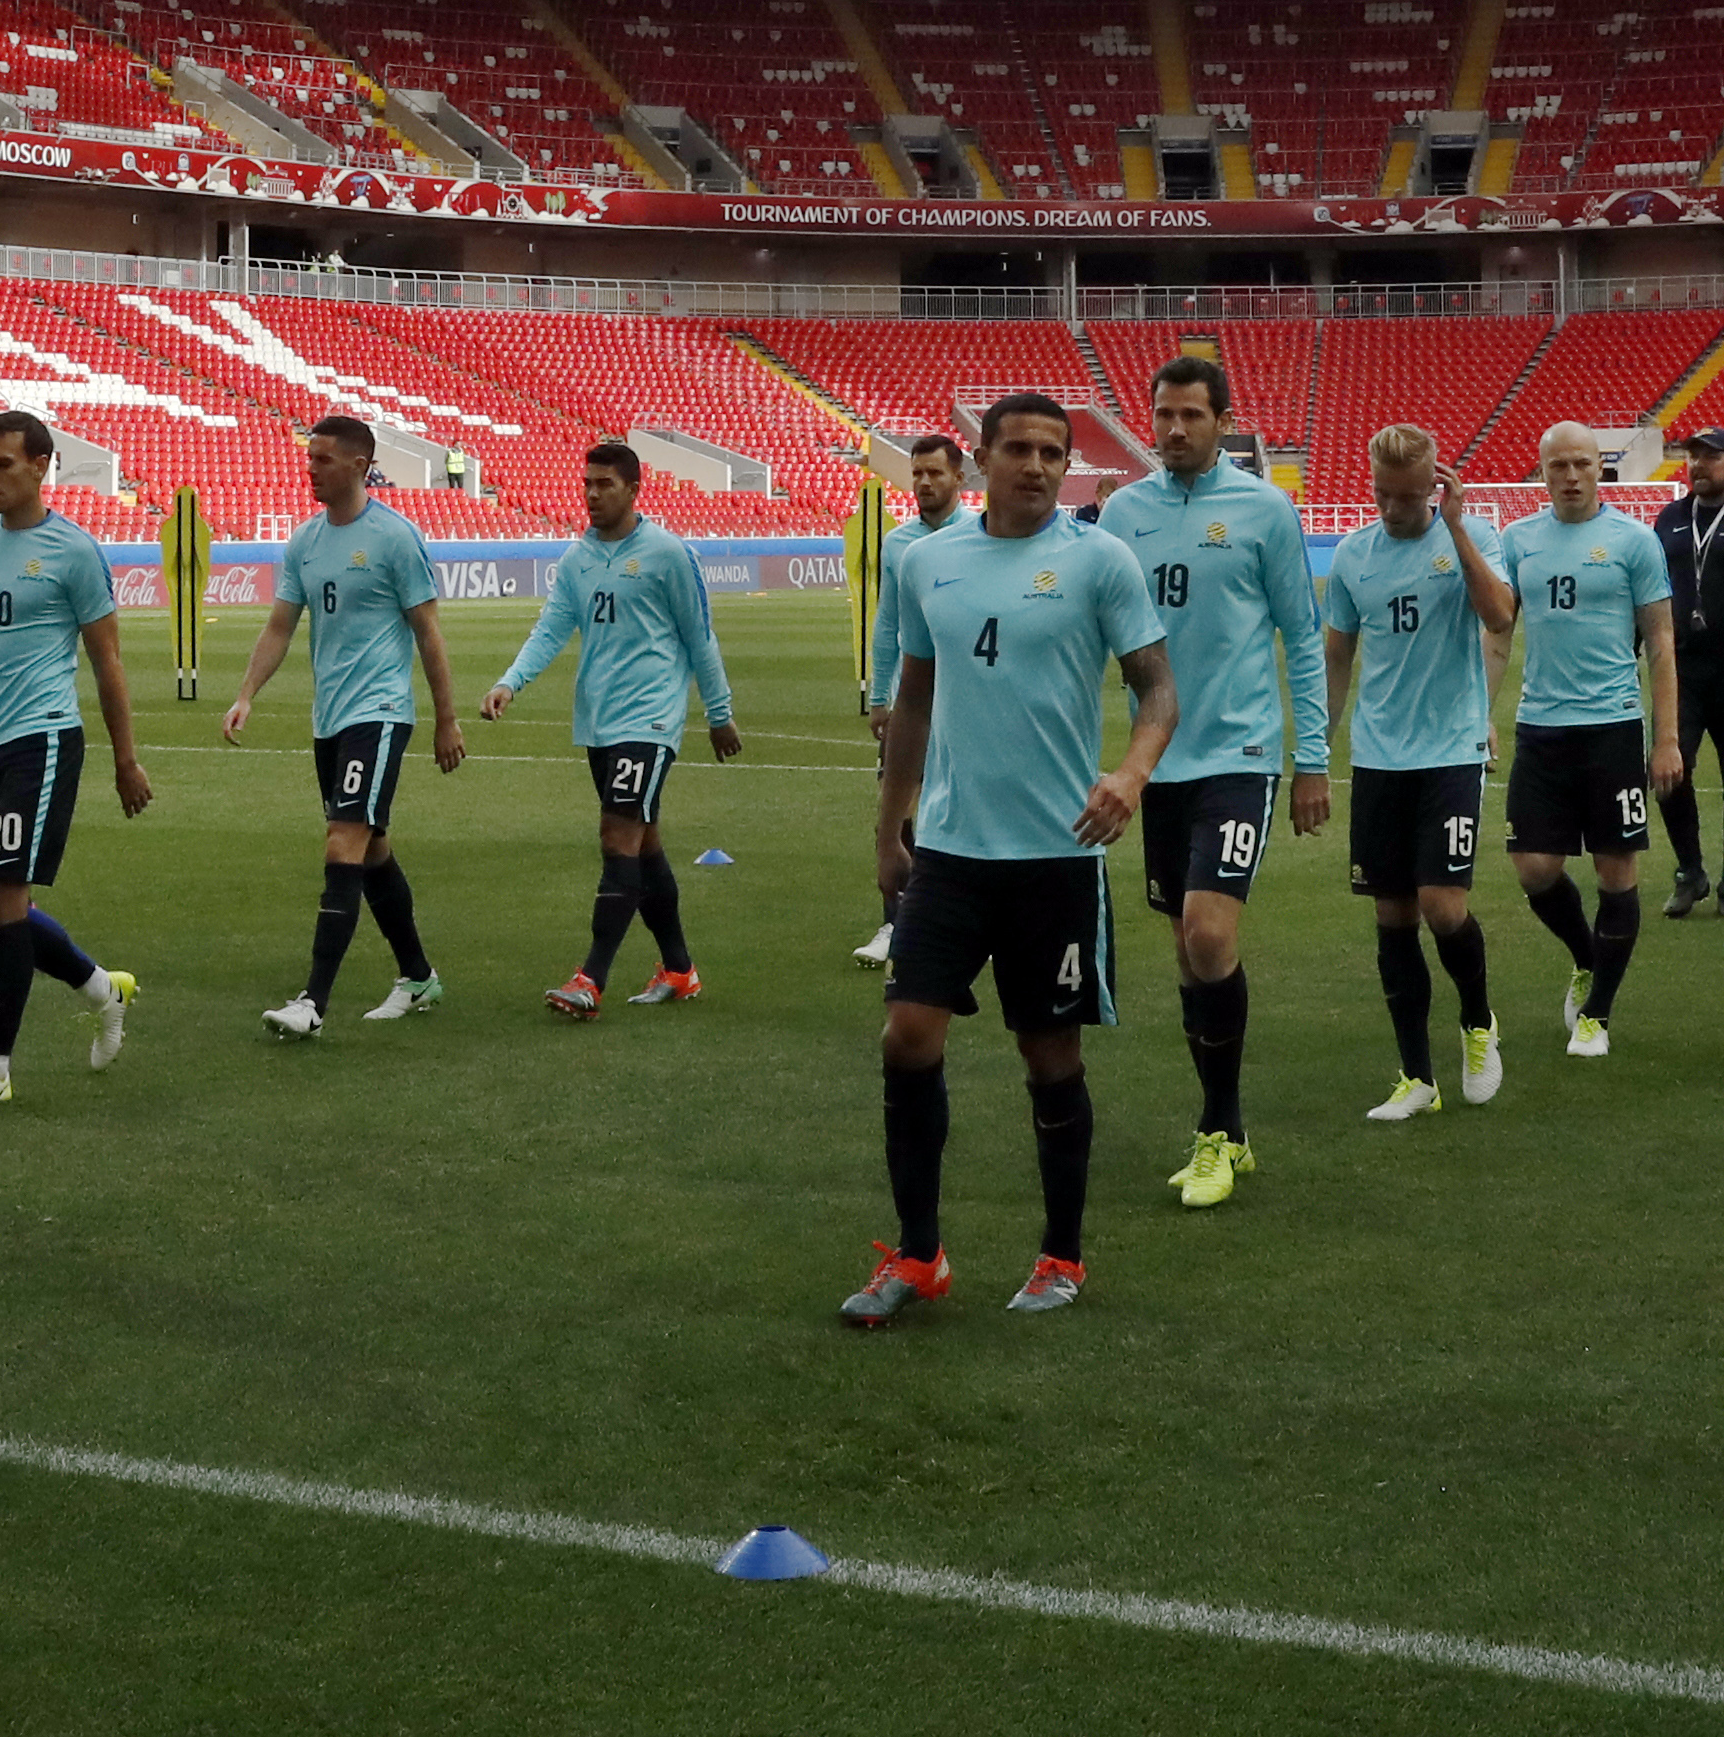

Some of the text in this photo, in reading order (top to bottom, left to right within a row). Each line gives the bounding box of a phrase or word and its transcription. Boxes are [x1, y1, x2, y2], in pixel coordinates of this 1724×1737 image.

[720, 202, 1212, 228] TOURNAMENT OF CHAMPIONS. DREAM OF FANS.
[111, 567, 160, 606] a-Cola
[203, 566, 260, 604] a-Cola
[436, 561, 501, 599] VISA
[705, 564, 750, 583] WANDA
[1153, 562, 1189, 609] 19
[1546, 574, 1576, 610] 13
[322, 580, 337, 614] 6
[593, 590, 616, 624] 21
[1022, 592, 1064, 600] AUSTRALIA
[1387, 594, 1420, 634] 15
[973, 616, 999, 668] 4
[342, 759, 364, 795] 6
[611, 757, 645, 794] 21
[1615, 787, 1648, 826] 13
[1218, 819, 1258, 869] 19
[1443, 815, 1475, 858] 15
[1056, 941, 1083, 992] 4
